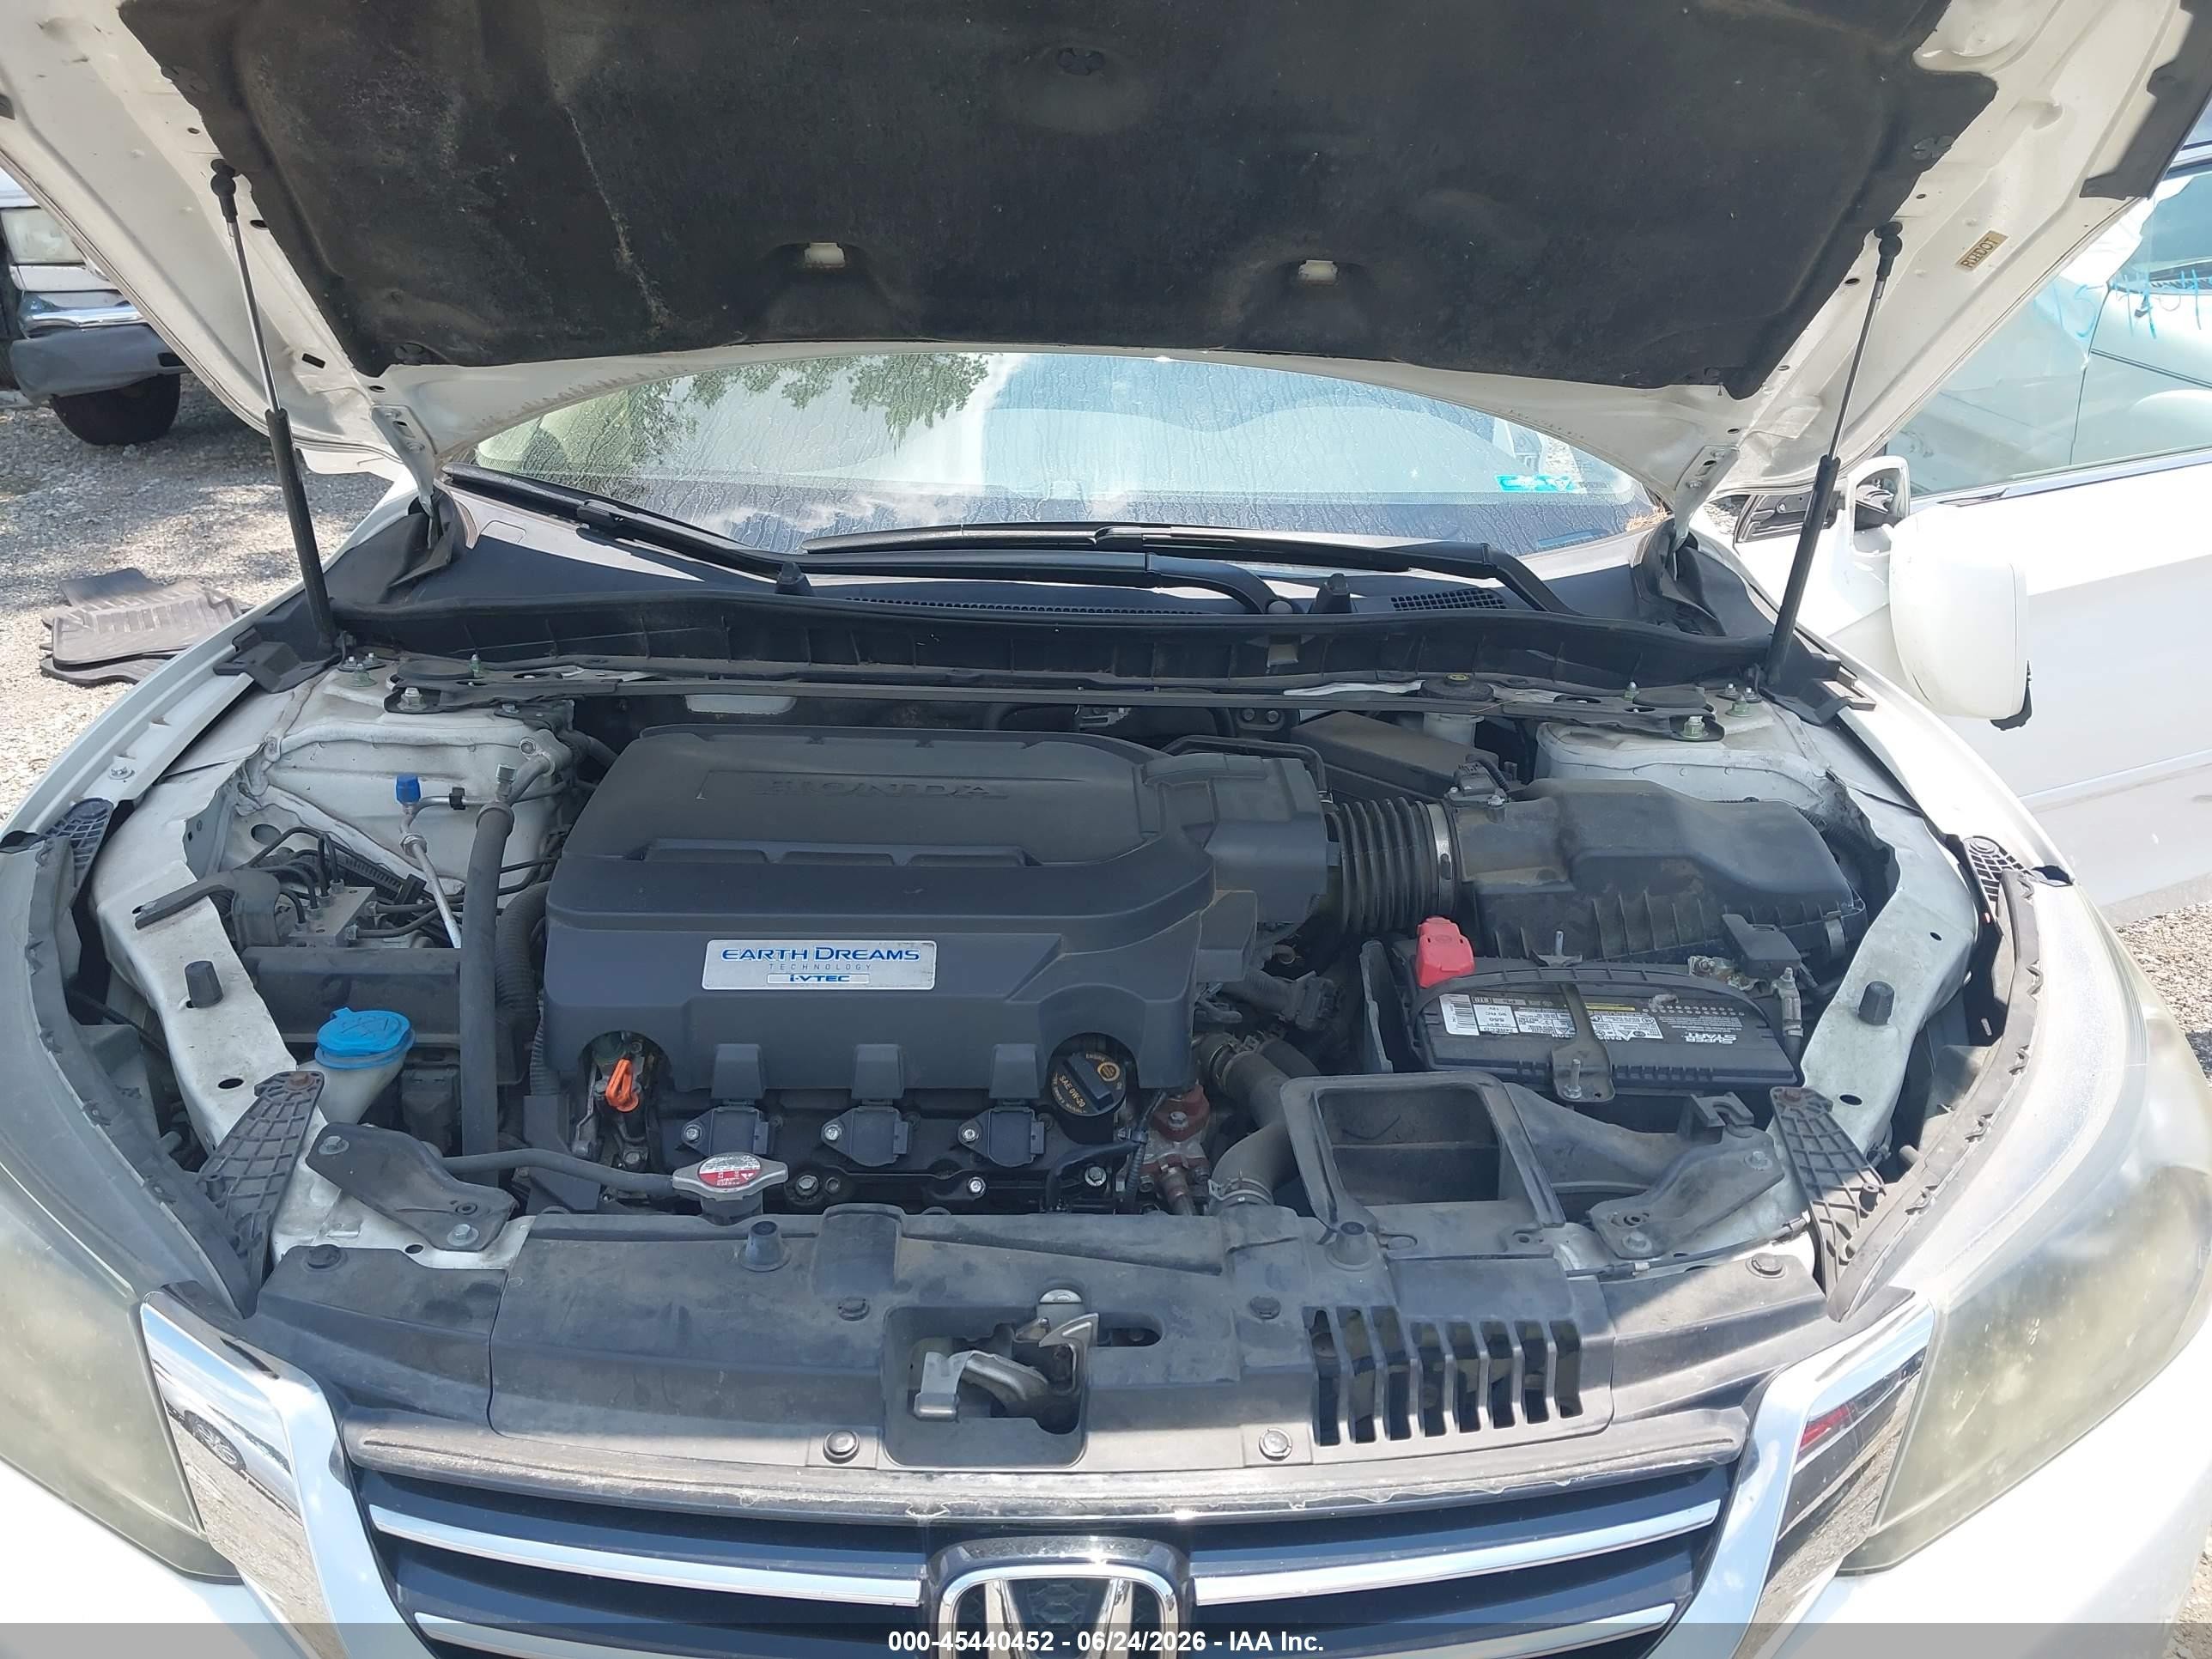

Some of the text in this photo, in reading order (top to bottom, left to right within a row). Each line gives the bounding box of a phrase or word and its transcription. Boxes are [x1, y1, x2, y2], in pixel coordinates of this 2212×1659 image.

[721, 946, 920, 961] EARTH DREAMS
[1059, 1075, 1073, 1091] SAE
